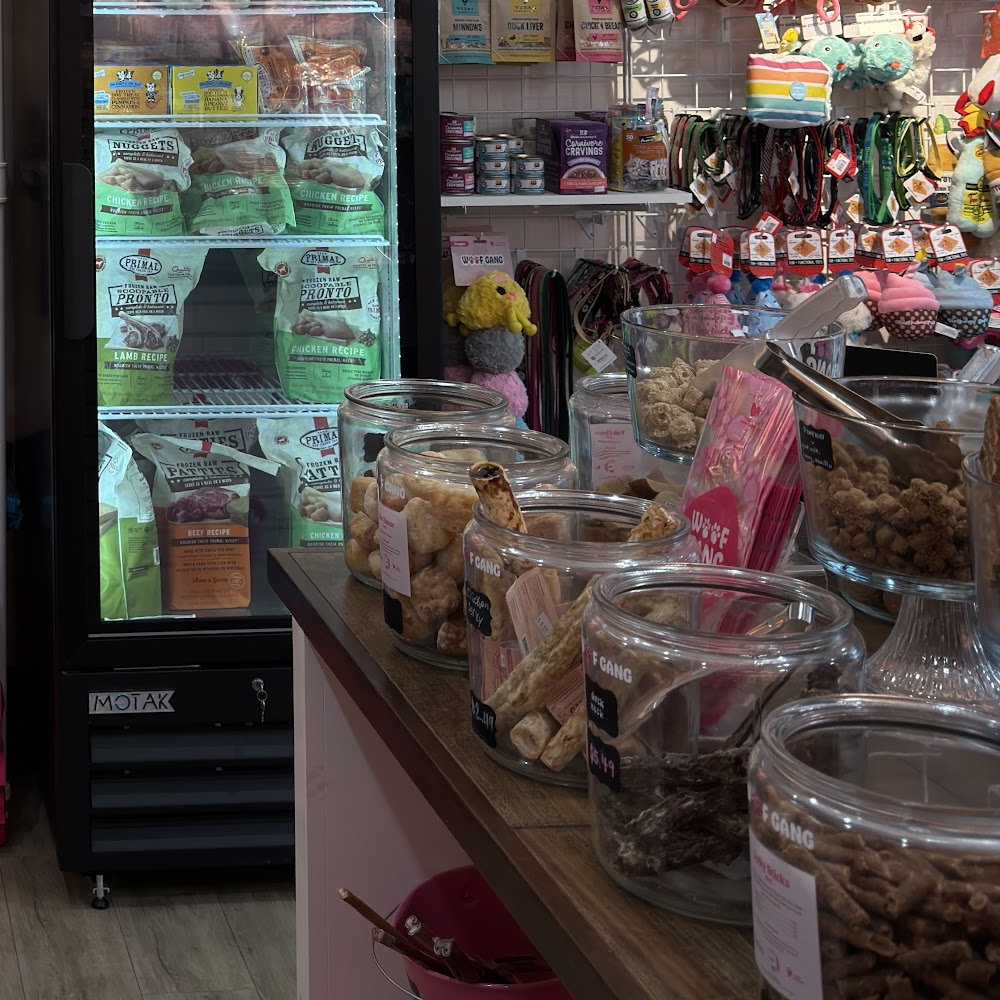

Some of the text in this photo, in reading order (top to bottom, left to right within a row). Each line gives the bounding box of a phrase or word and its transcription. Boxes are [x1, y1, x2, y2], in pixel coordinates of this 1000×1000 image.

[453, 24, 482, 32] MINNOWS
[507, 22, 544, 31] DUCK LIVER
[581, 22, 604, 30] CHICKEN
[112, 140, 174, 150] NUGGETS
[565, 139, 603, 148] Carnivore
[566, 147, 603, 156] CRAVINGS
[202, 177, 263, 191] CHICKEN RECIPE
[107, 194, 168, 207] CHICKEN RECIPE
[300, 190, 336, 200] CHICKEN
[124, 258, 160, 271] PRIMAL
[304, 254, 343, 265] PRIMAL
[485, 256, 504, 264] GANG
[117, 293, 169, 304] PRONTO
[300, 287, 352, 300] PRONTO
[292, 346, 364, 356] CHICKEN RECIPE
[114, 352, 168, 362] LAMB RECIPE
[167, 466, 238, 477] PATTIES
[385, 482, 406, 500] GANG
[475, 558, 500, 578] GANG
[600, 656, 632, 684] GANG
[94, 693, 169, 711] MOTAK
[771, 812, 814, 850] GANG
[766, 863, 790, 888] Sticks
